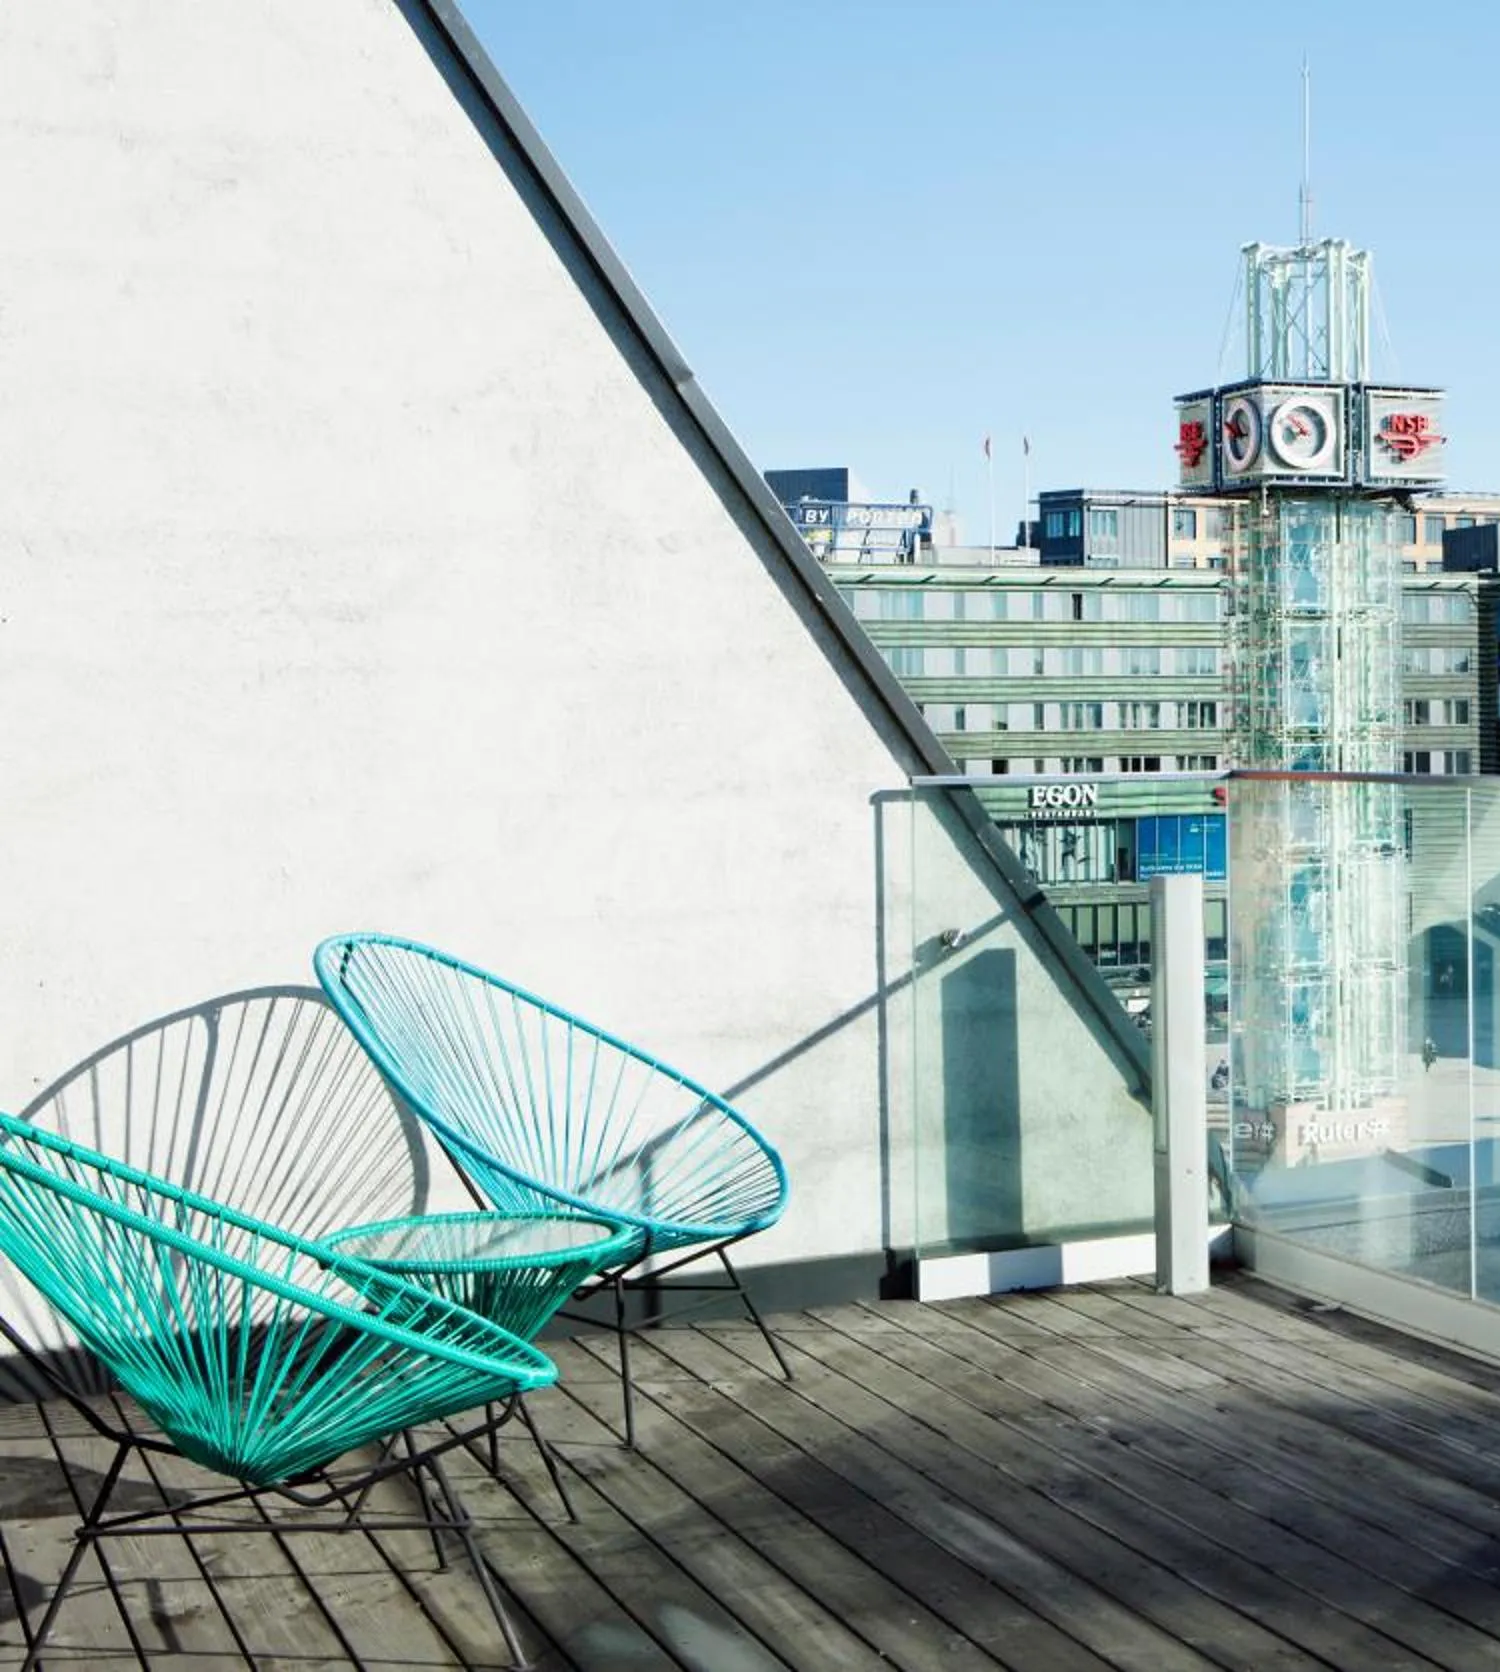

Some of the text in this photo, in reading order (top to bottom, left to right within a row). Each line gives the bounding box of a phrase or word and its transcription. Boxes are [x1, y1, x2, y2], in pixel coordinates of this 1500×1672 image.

[1391, 413, 1430, 433] NSB
[805, 509, 829, 523] BY
[1032, 783, 1098, 806] EGON
